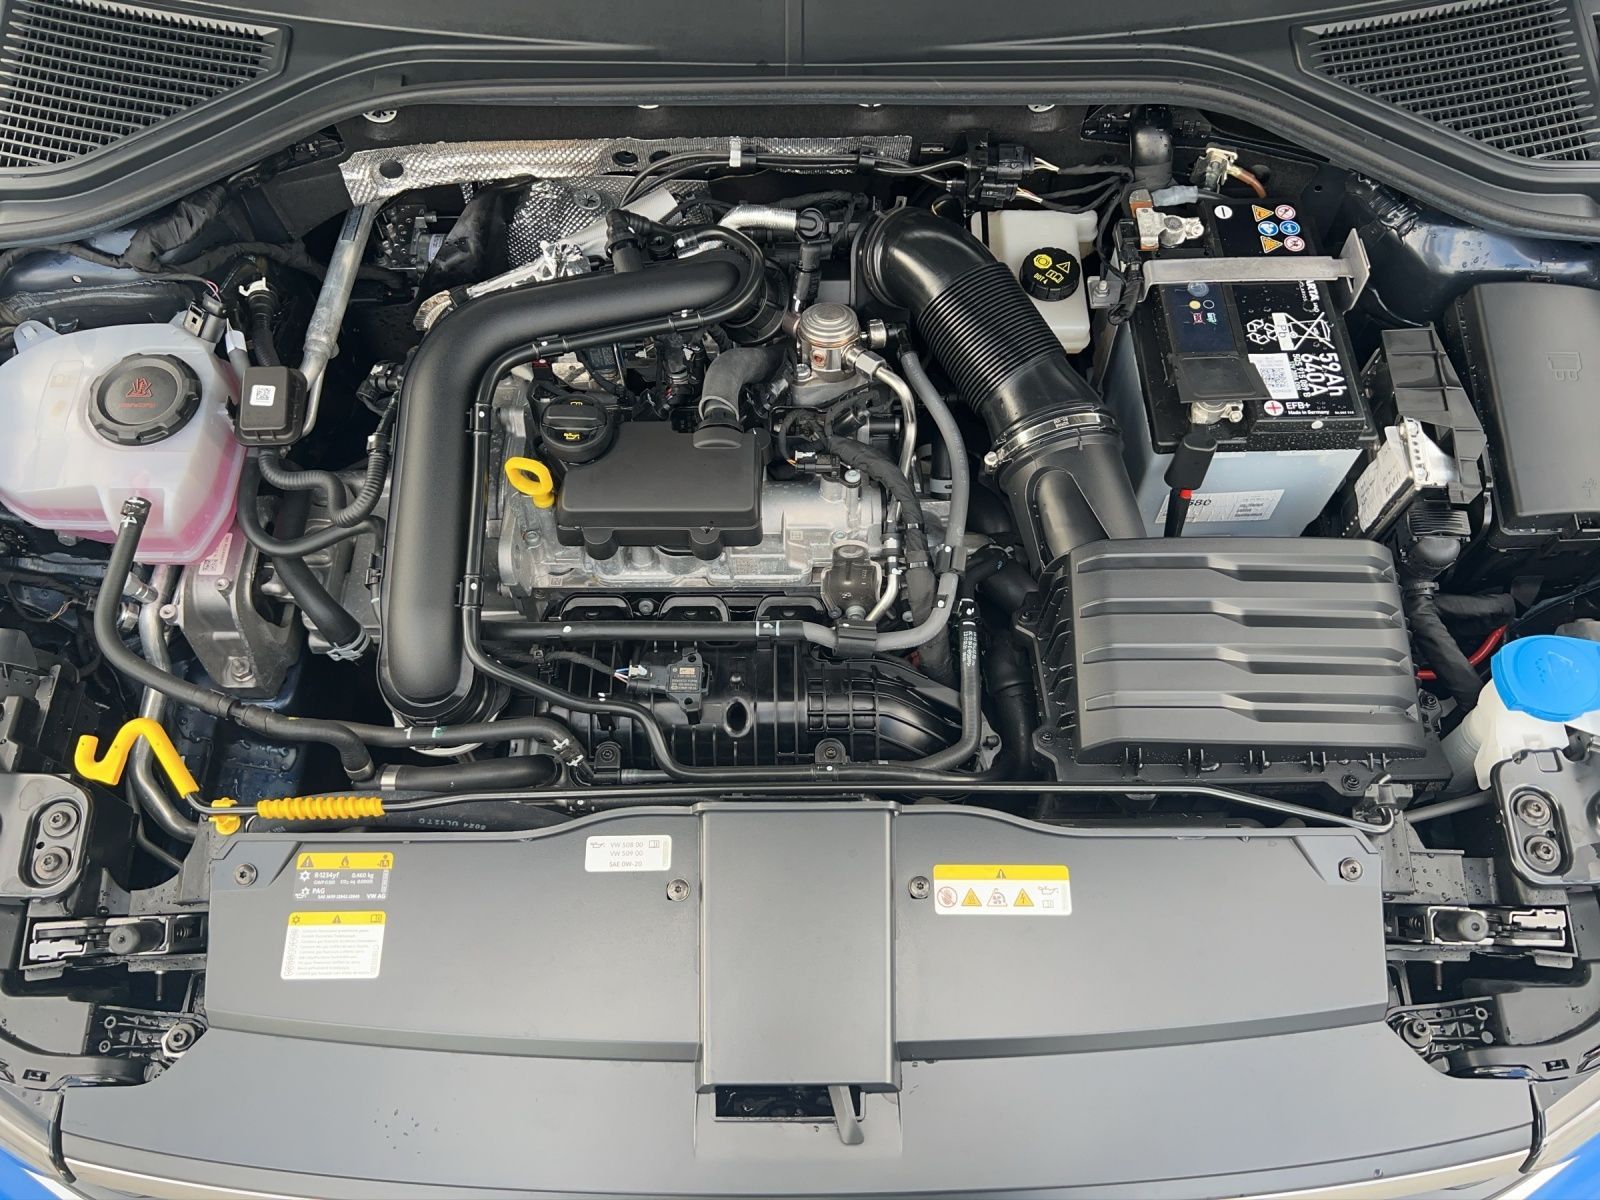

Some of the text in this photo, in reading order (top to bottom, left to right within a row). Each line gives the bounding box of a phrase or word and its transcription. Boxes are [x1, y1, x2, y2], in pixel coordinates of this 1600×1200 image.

[1305, 280, 1320, 301] ARTA
[1278, 325, 1287, 338] Pb
[1301, 353, 1329, 397] 640A
[1320, 352, 1347, 397] 59Ah
[1285, 401, 1311, 410] EFB+
